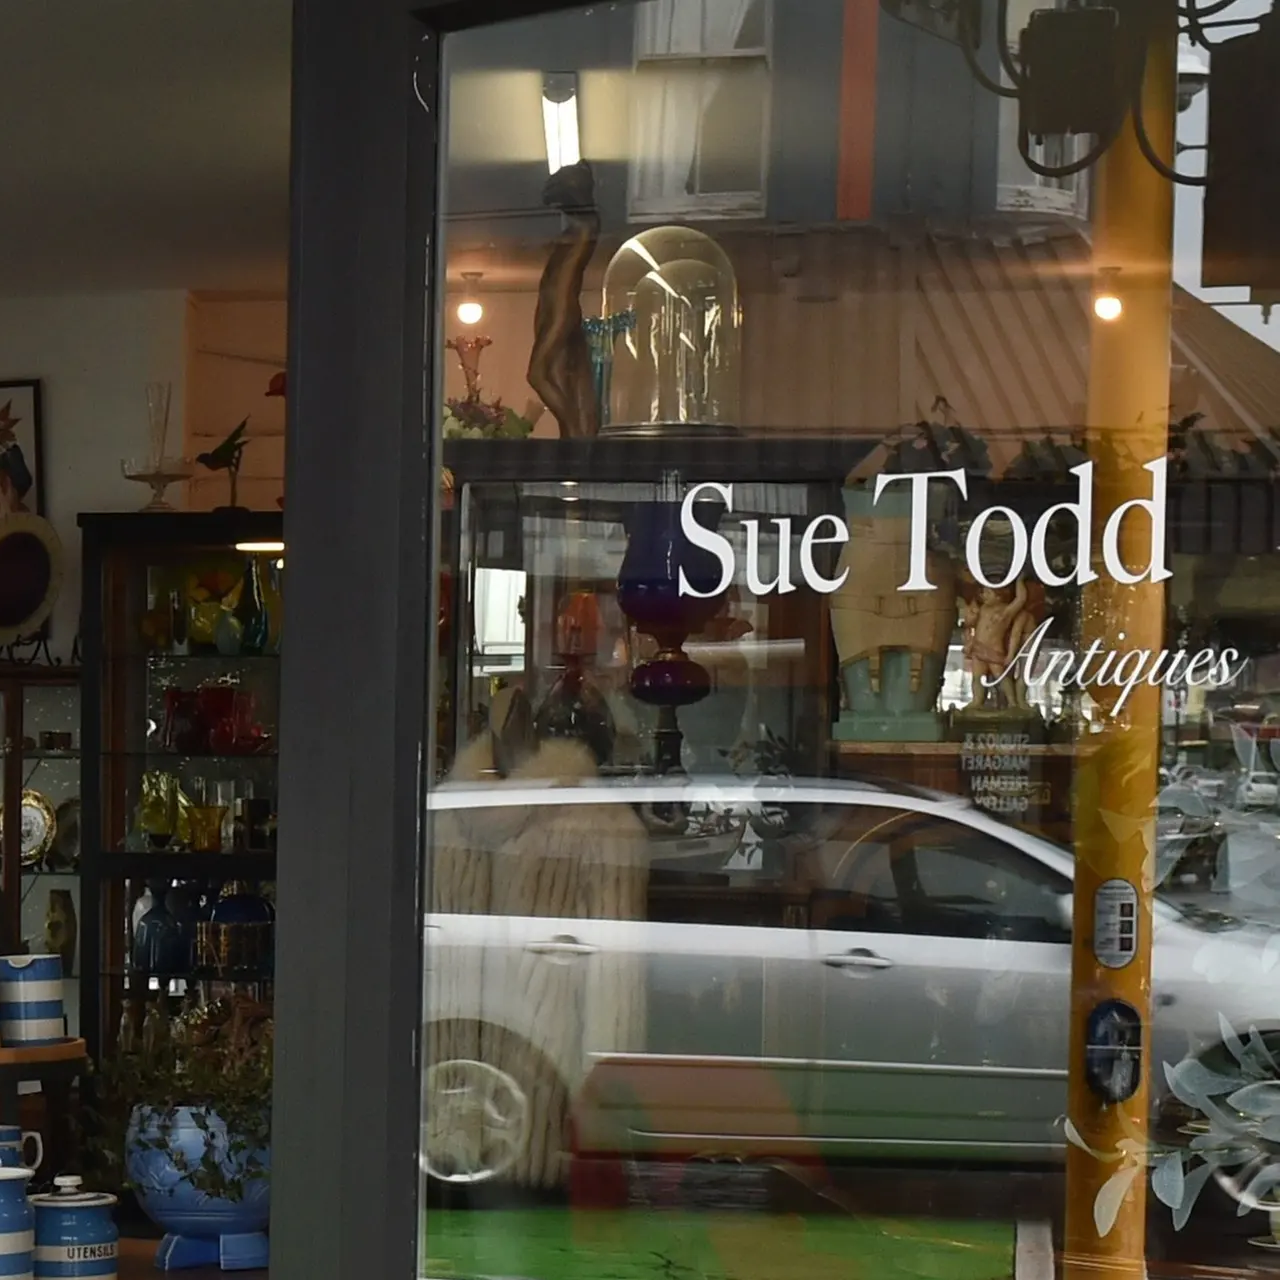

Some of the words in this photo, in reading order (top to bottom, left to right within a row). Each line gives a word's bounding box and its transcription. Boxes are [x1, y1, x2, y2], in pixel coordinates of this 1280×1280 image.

[679, 482, 850, 598] Sue
[873, 456, 1174, 592] Todd
[981, 617, 1249, 717] Antiques
[67, 1243, 115, 1259] UTENSILS
